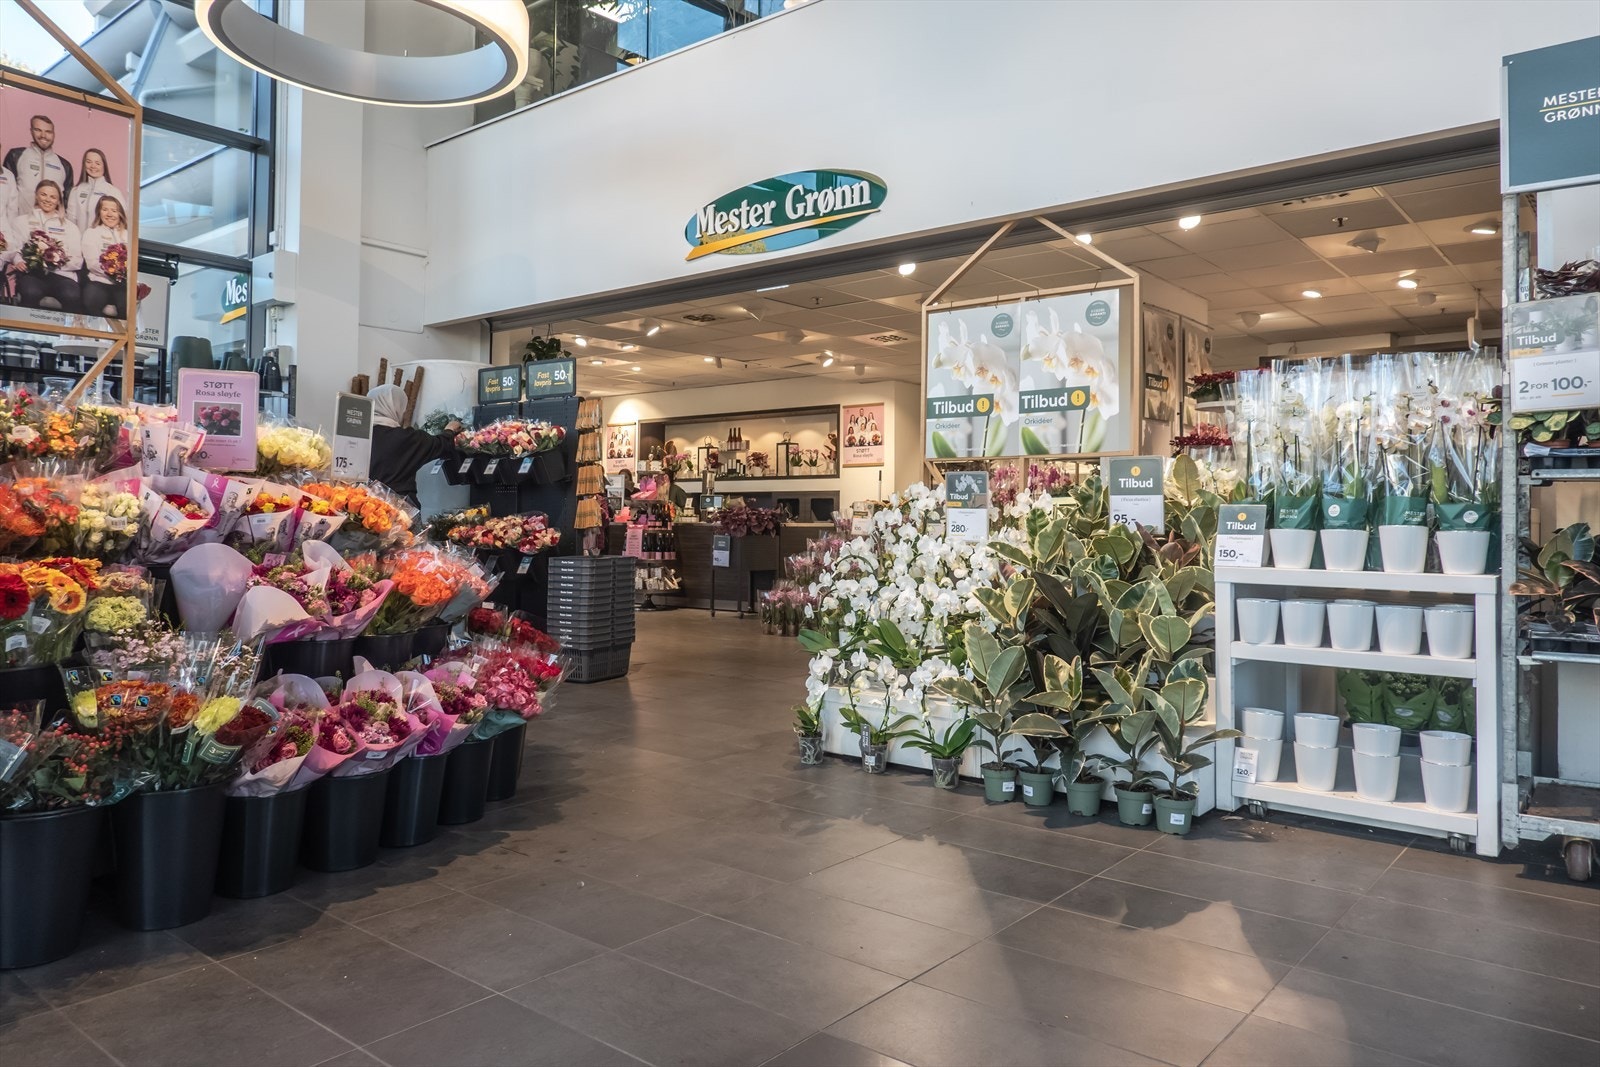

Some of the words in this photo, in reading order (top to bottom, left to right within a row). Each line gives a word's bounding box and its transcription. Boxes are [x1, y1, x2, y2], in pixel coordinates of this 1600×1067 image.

[1543, 87, 1600, 107] MESTE
[695, 200, 777, 238] Mester
[785, 180, 872, 220] Grønn
[1517, 332, 1557, 346] Tilbud
[203, 381, 234, 390] STØTT
[1519, 380, 1529, 393] 2
[1551, 376, 1592, 391] 100,-
[195, 389, 216, 397] Rosa
[216, 389, 242, 399] sløyfe
[1021, 392, 1068, 409] Tilbud
[933, 399, 974, 415] Tilbud
[1118, 477, 1153, 488] Tilbud
[1113, 514, 1137, 525] 95,-
[1226, 521, 1257, 531] Tilbud
[1218, 549, 1244, 559] 150,-
[1236, 768, 1253, 777] 120,-
